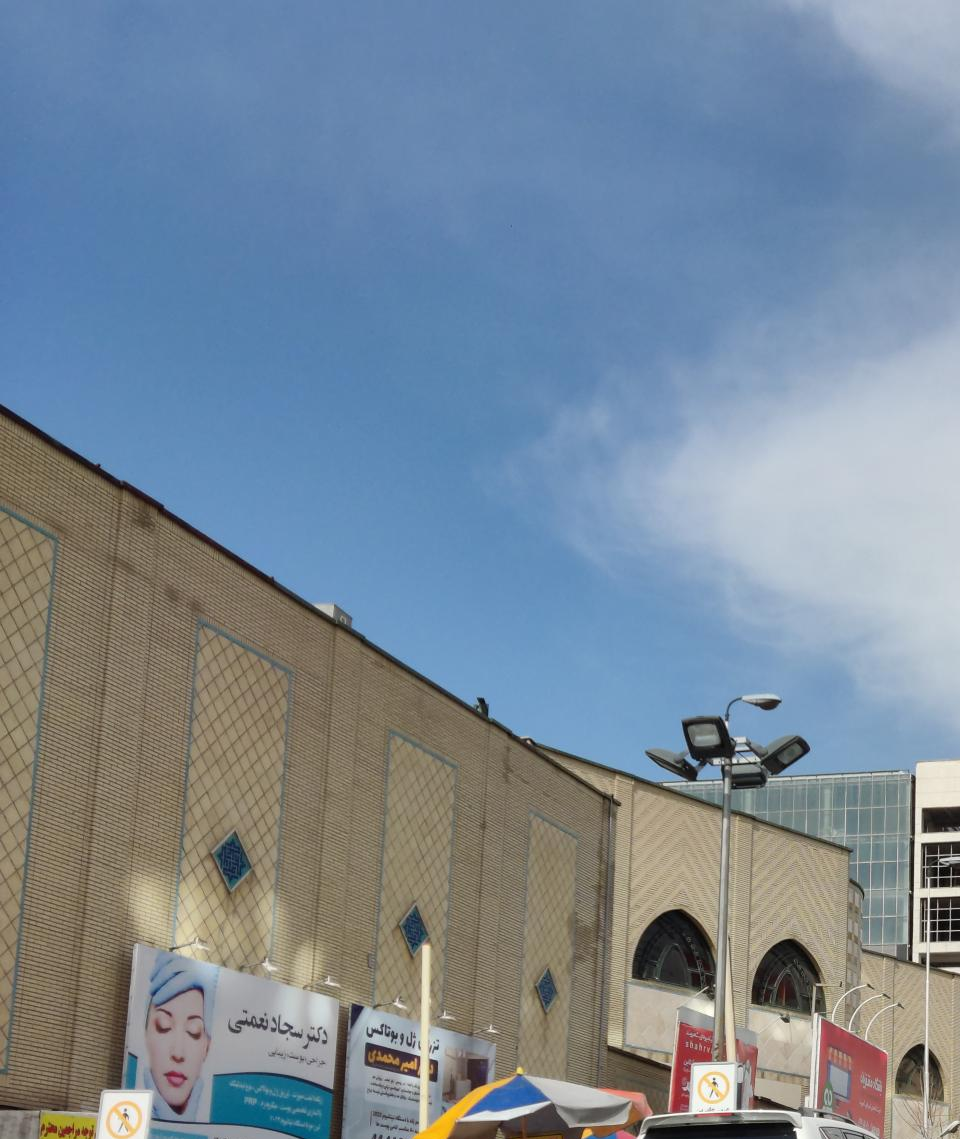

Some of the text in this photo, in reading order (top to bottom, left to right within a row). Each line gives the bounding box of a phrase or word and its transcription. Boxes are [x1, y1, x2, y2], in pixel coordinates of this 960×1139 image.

[228, 1009, 328, 1049] دکتر سجاد نعمتی
[366, 1023, 398, 1046] بوتاکس
[406, 1032, 416, 1049] ژل
[685, 1040, 713, 1055] shahrv
[368, 1049, 400, 1067] محمدی
